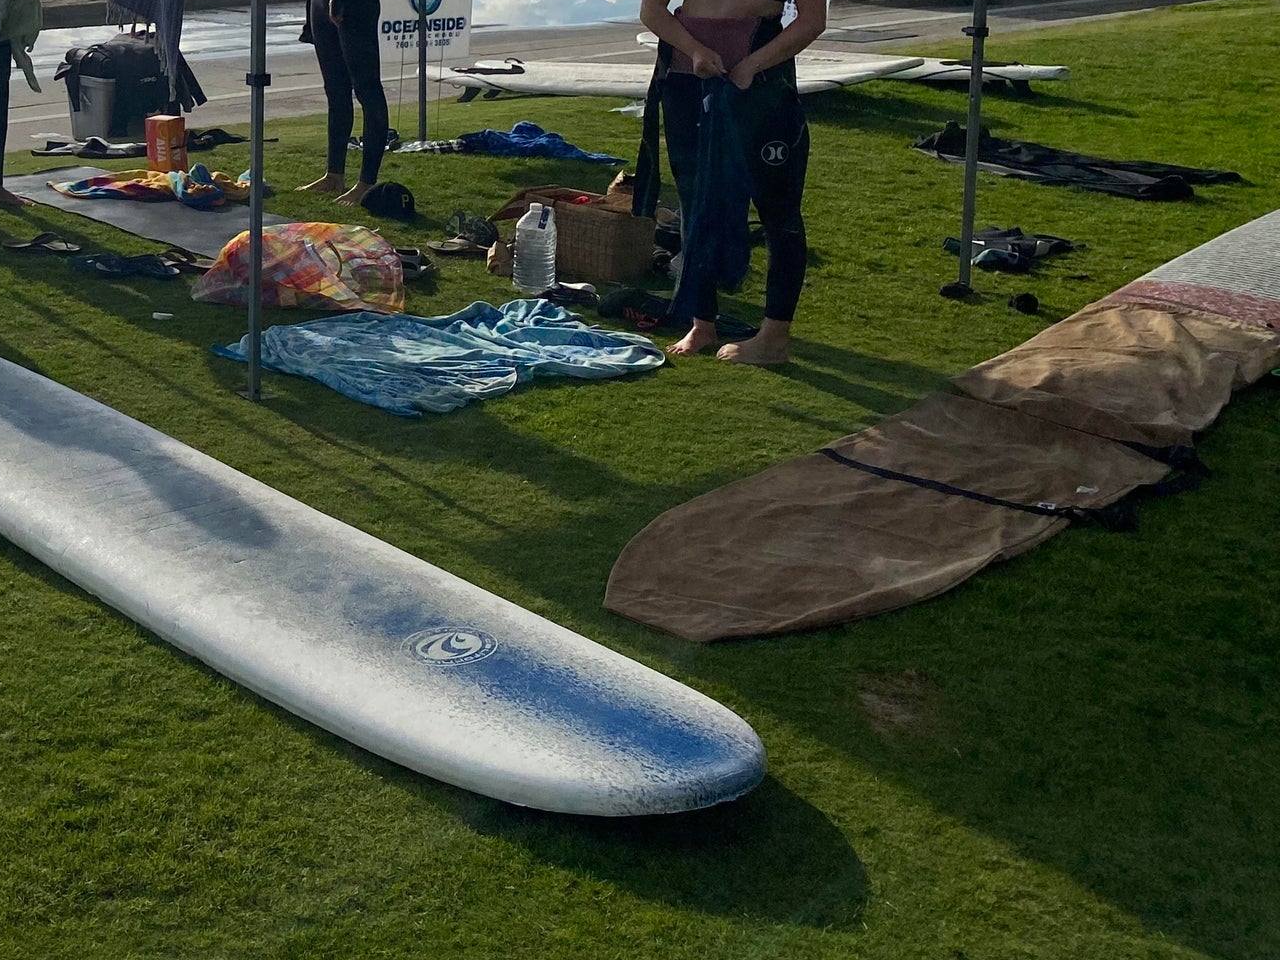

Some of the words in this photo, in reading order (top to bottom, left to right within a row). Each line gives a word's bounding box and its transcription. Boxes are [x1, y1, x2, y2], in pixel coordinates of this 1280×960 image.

[381, 17, 465, 34] OCEANSIDE
[427, 31, 461, 39] CHOOL
[156, 138, 167, 162] AHA
[401, 193, 410, 209] P
